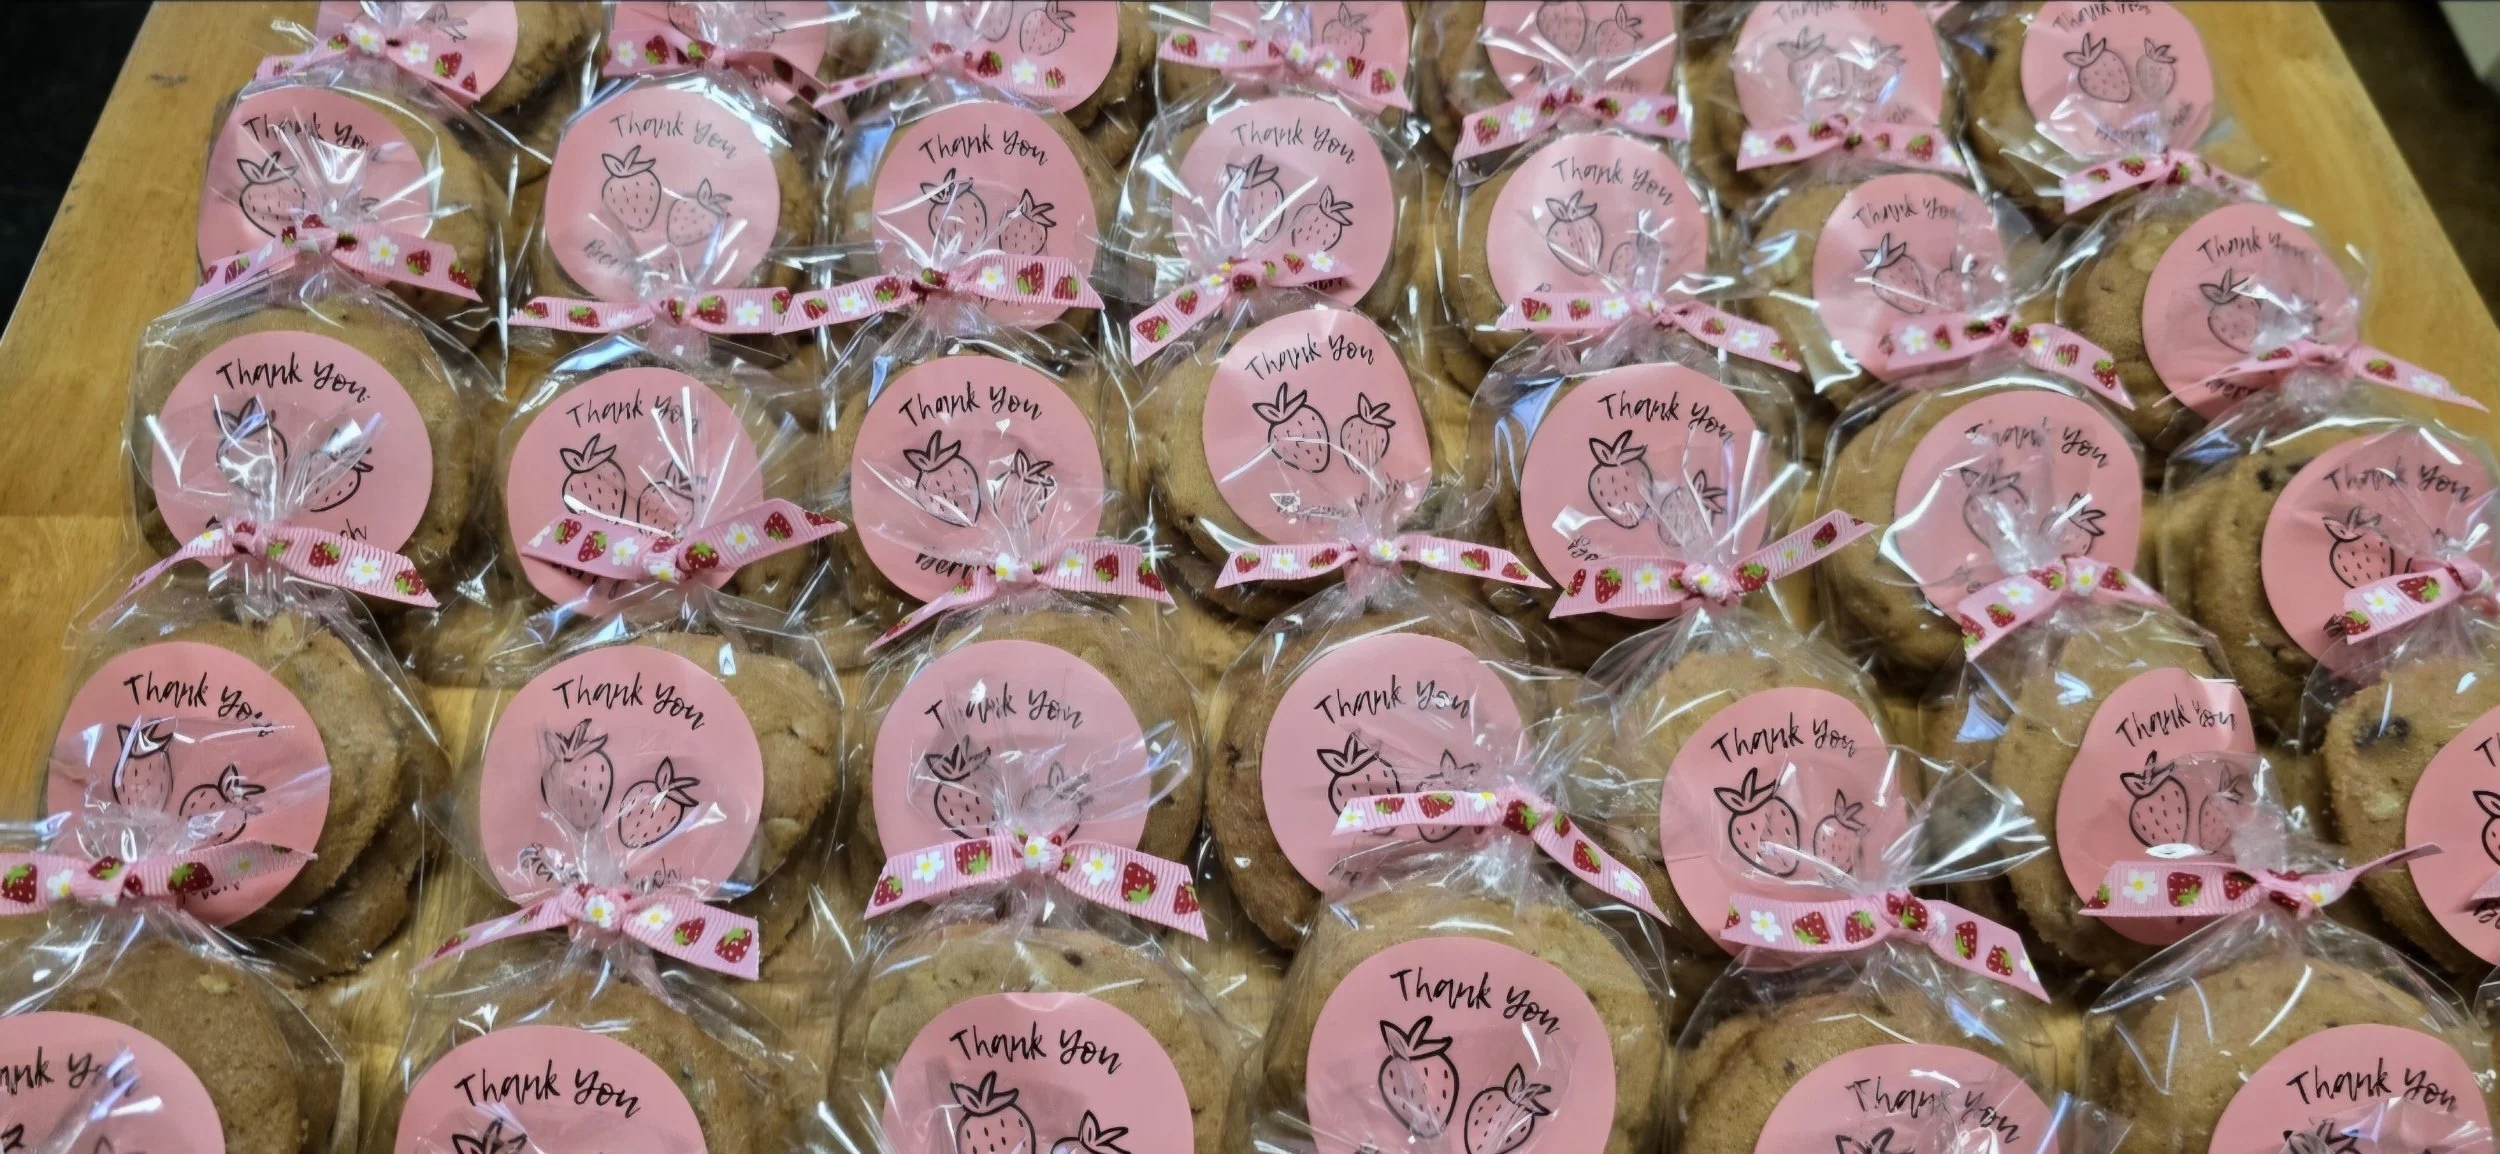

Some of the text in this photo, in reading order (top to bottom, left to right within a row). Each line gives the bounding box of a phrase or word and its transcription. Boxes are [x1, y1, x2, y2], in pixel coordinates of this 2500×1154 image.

[242, 113, 382, 160] Thank Yo
[610, 112, 738, 159] Thank You
[919, 125, 1048, 165] Thank You
[1231, 119, 1356, 164] Thank You
[1552, 157, 1673, 206] Thank You
[2196, 230, 2263, 260] Thank
[216, 352, 372, 403] Thank You
[1245, 332, 1374, 380] Thank You
[566, 390, 645, 427] Thank
[899, 381, 1042, 428] Thank You
[1598, 391, 1734, 441] Thank You
[2060, 425, 2111, 469] You
[2417, 465, 2472, 503] You
[124, 672, 209, 709] Thank
[553, 672, 705, 730] Thank You
[1027, 689, 1084, 729] You
[1314, 675, 1471, 724] Thank You
[1710, 712, 1856, 763] Thank You
[2116, 693, 2236, 747] Thank You
[1390, 966, 1561, 1034] Thank You
[950, 1021, 1123, 1075] Thank You
[455, 1059, 641, 1118] Thank You
[2287, 1058, 2456, 1114] Thank You
[1964, 1091, 2020, 1144] You
